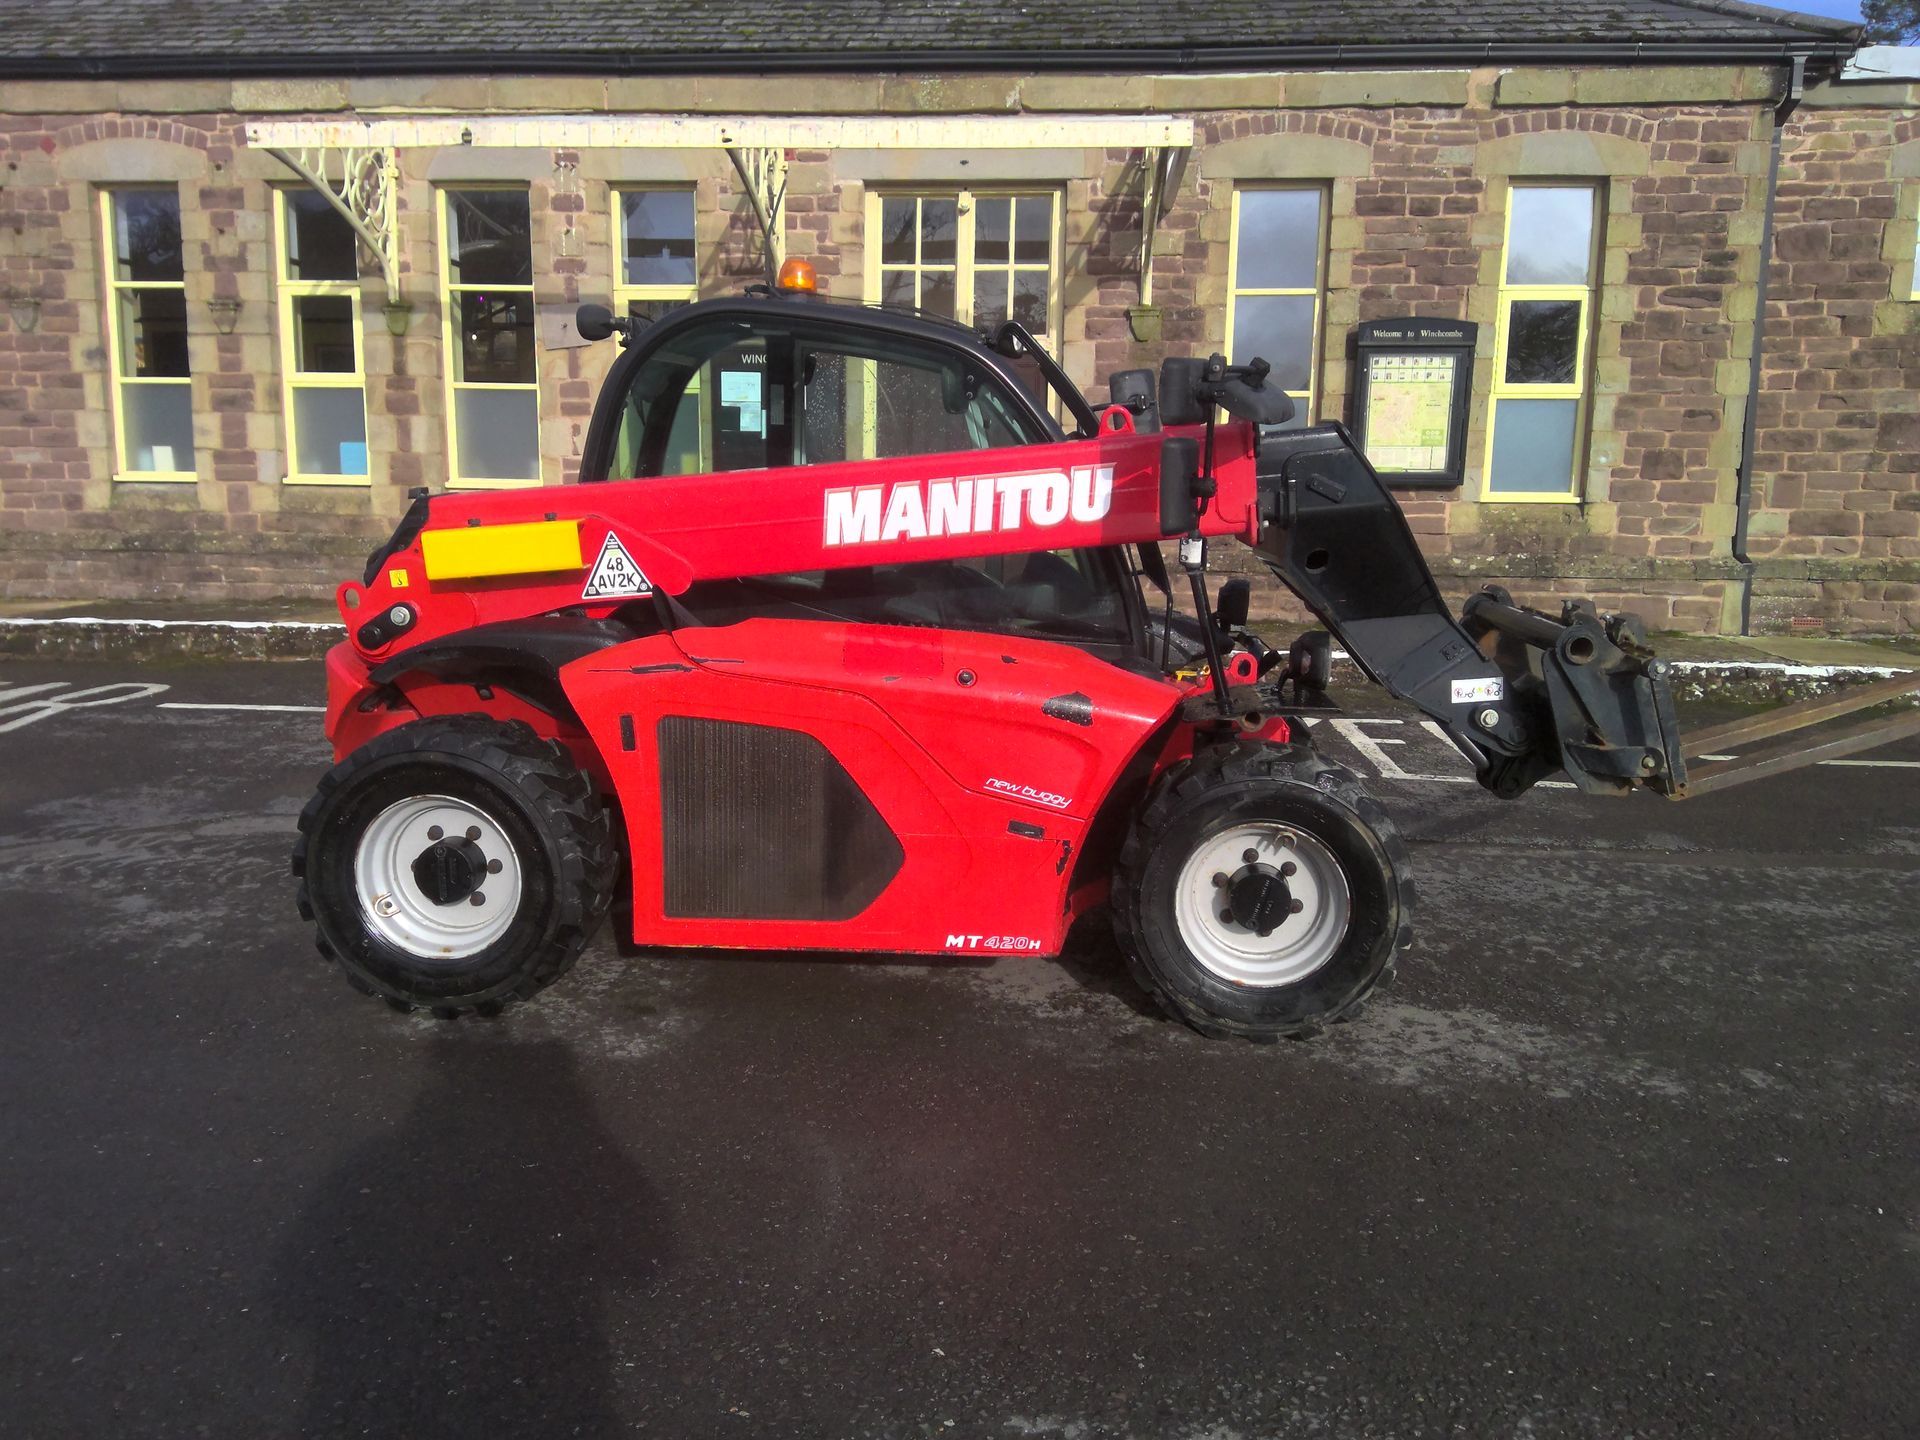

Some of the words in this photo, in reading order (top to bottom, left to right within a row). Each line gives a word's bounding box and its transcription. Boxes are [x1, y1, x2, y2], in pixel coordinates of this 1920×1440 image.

[1373, 329, 1403, 338] Welcome
[1407, 329, 1415, 338] to
[1420, 329, 1463, 338] Winchcombe
[823, 462, 1116, 548] MANITOU
[606, 557, 624, 572] 48
[598, 572, 637, 589] AV2K
[986, 777, 1021, 792] new
[1021, 785, 1072, 809] buggy
